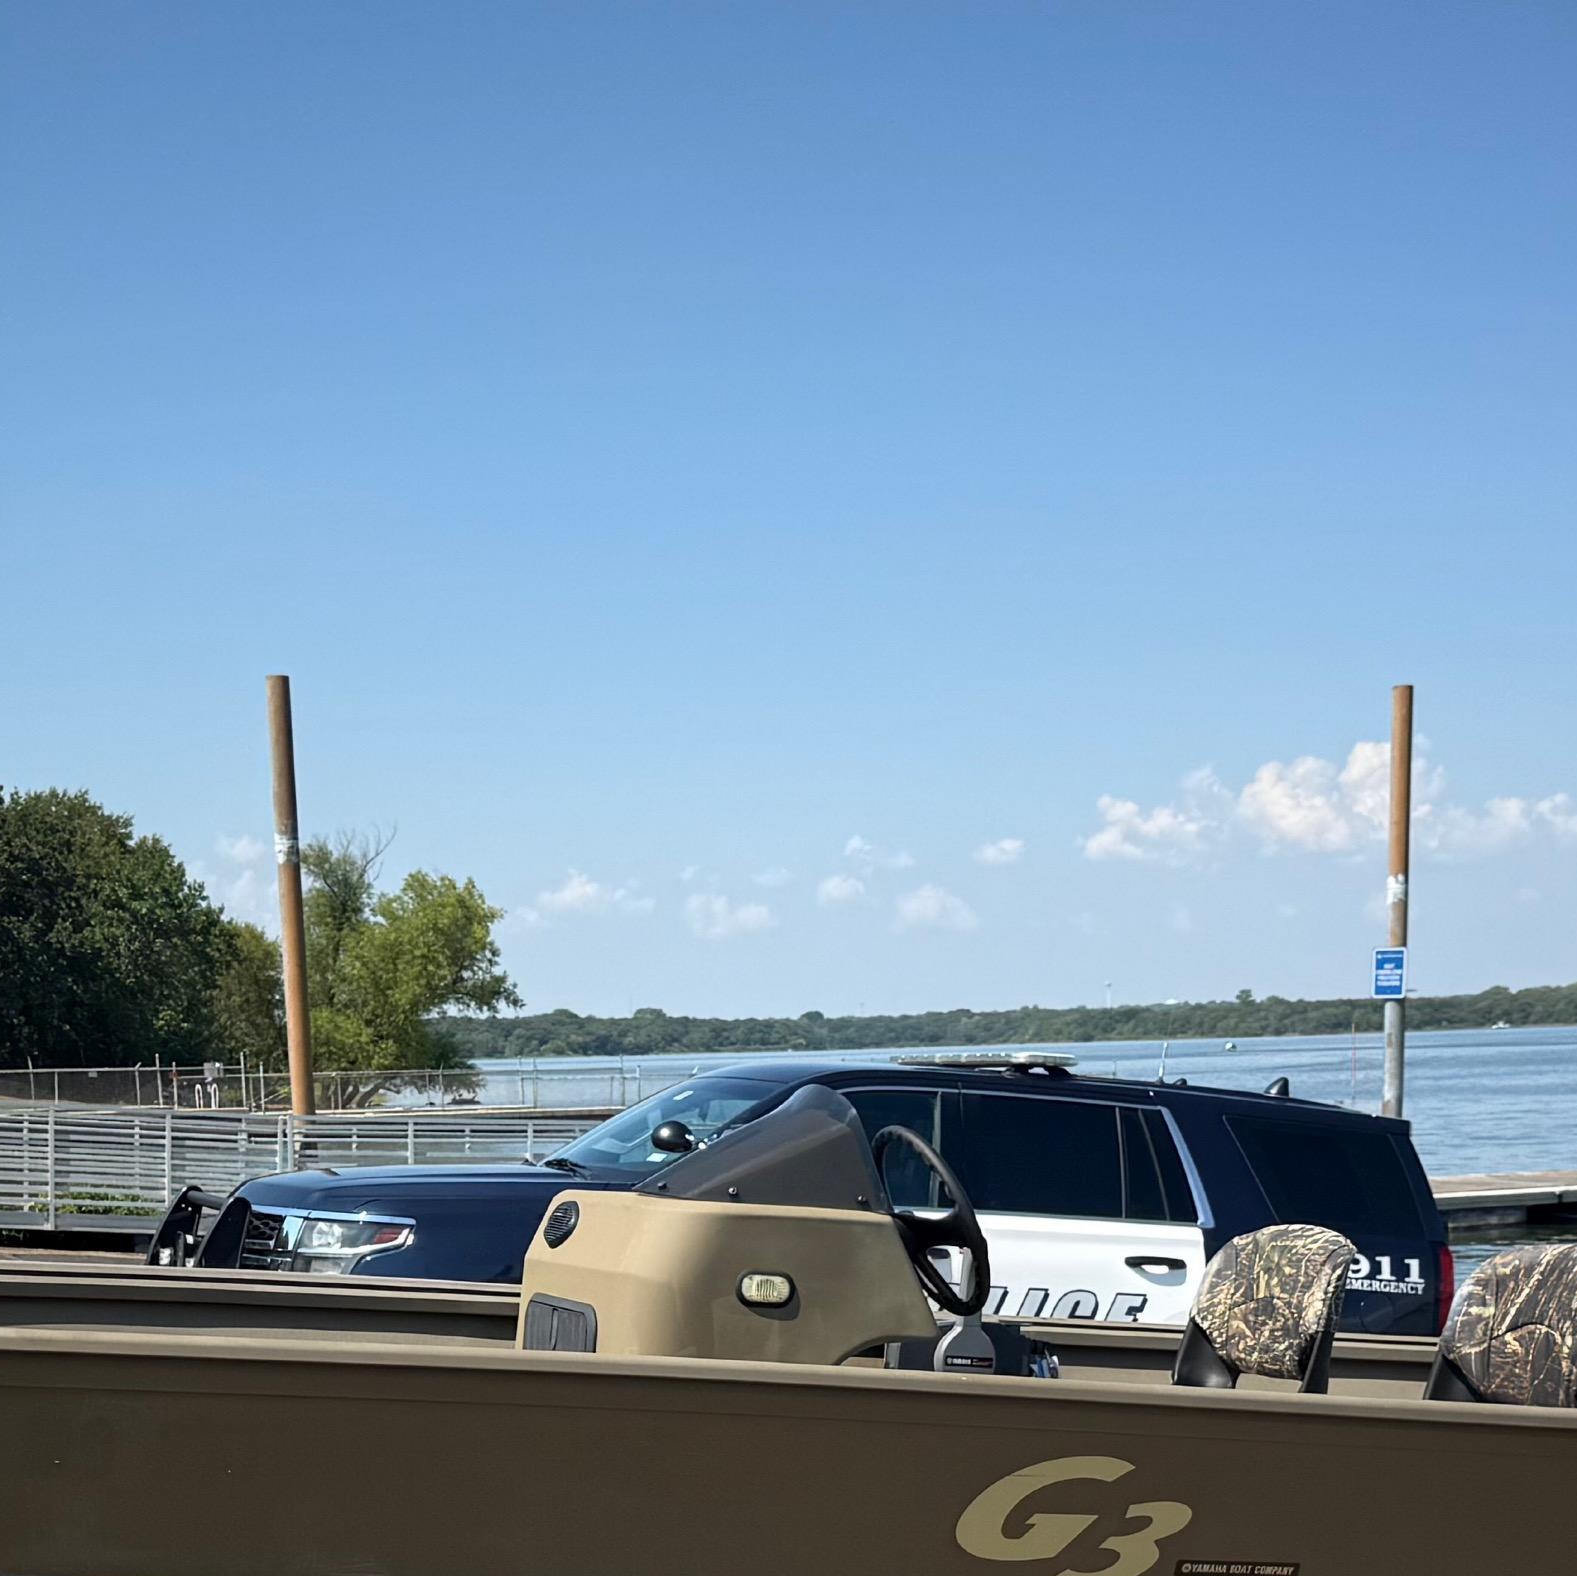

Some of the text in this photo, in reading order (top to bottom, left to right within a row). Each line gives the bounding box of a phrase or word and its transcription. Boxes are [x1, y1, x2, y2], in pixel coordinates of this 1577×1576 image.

[1347, 1252, 1425, 1283] 911
[1191, 1563, 1227, 1574] YAMAHA
[1253, 1565, 1295, 1576] COMPANY
